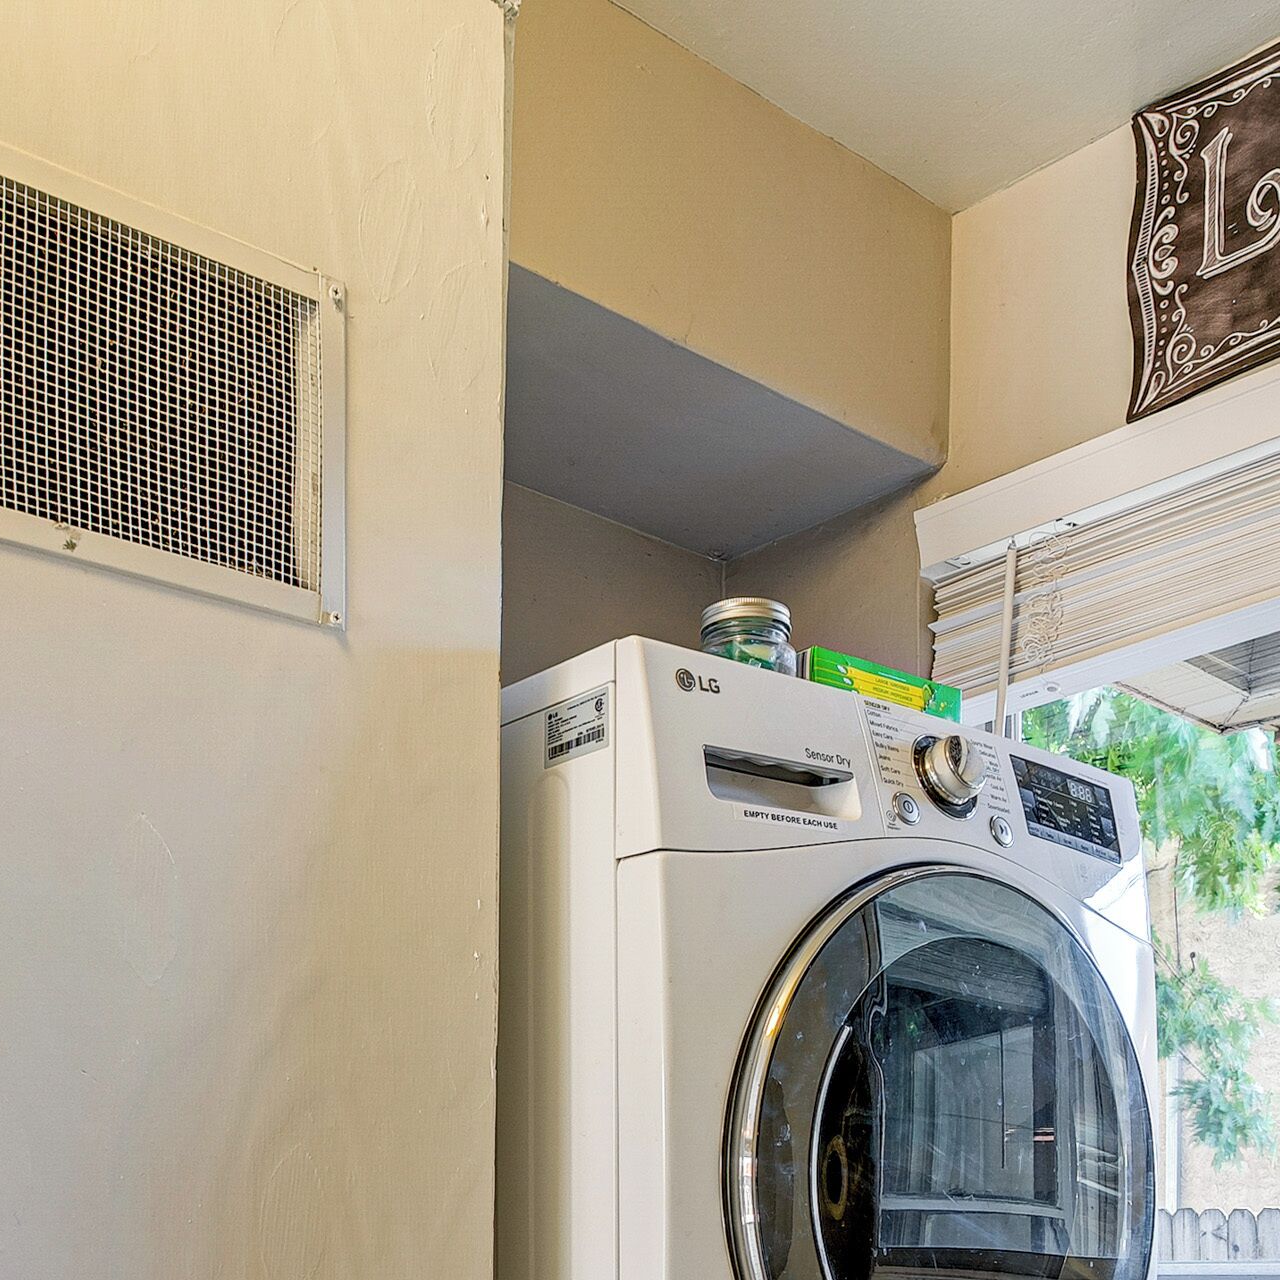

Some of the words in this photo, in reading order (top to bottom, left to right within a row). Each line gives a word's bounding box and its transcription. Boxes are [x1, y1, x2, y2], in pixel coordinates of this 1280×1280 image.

[699, 675, 721, 694] LG
[805, 747, 835, 765] Sensor
[836, 754, 852, 769] Dry
[743, 809, 770, 821] EMPTY
[771, 812, 802, 825] BEFORE
[802, 816, 823, 828] EACH
[823, 820, 839, 830] USE
